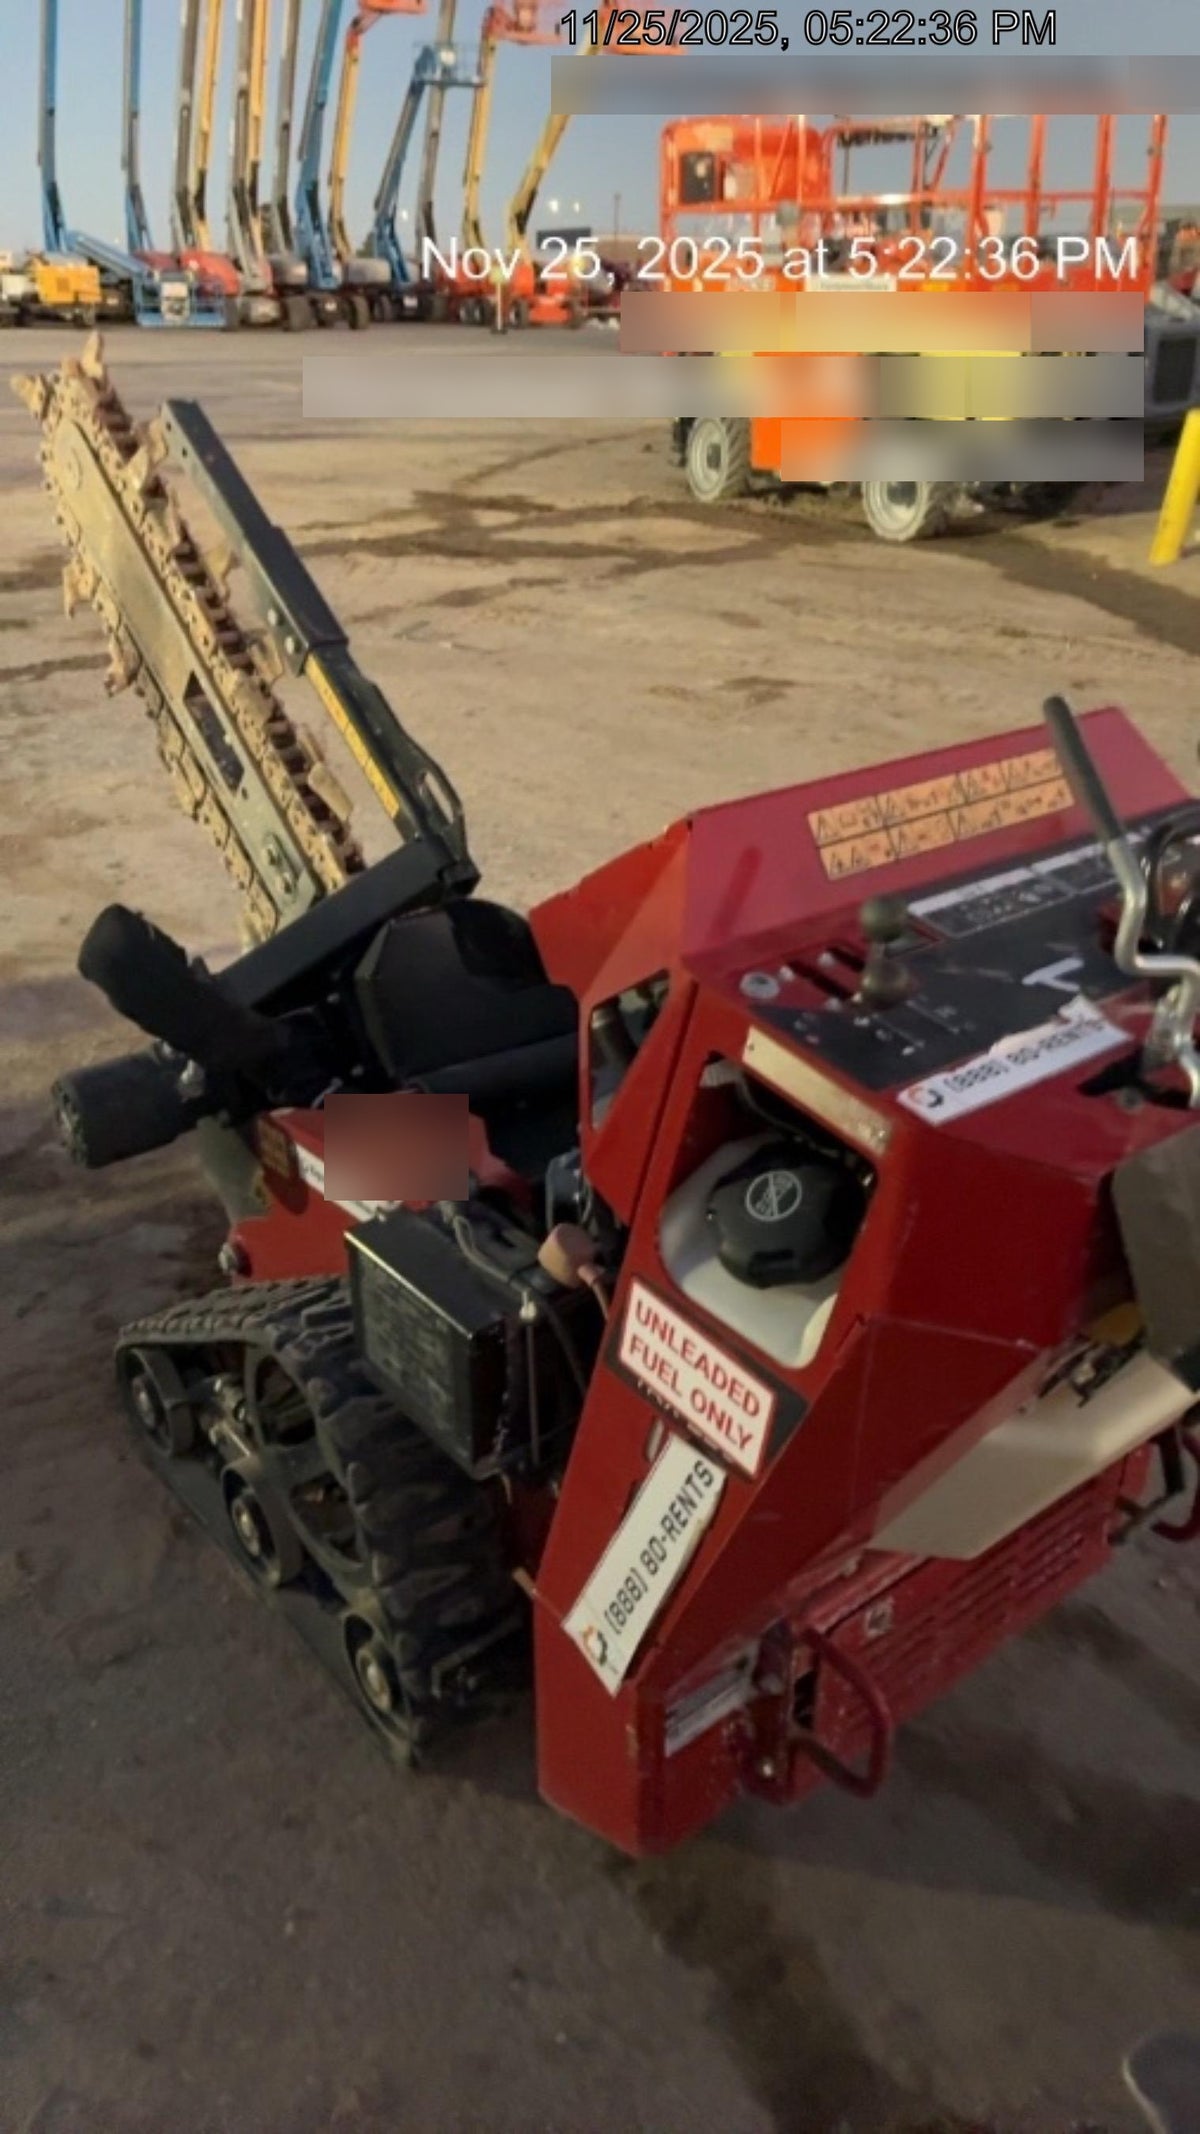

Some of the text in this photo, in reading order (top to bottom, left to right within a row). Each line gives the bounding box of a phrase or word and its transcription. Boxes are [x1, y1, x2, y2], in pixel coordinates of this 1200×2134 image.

[629, 1333, 684, 1399] FUEL
[690, 1387, 753, 1450] ONLY
[636, 1300, 761, 1417] UNLEADED
[604, 1567, 649, 1635] (888)
